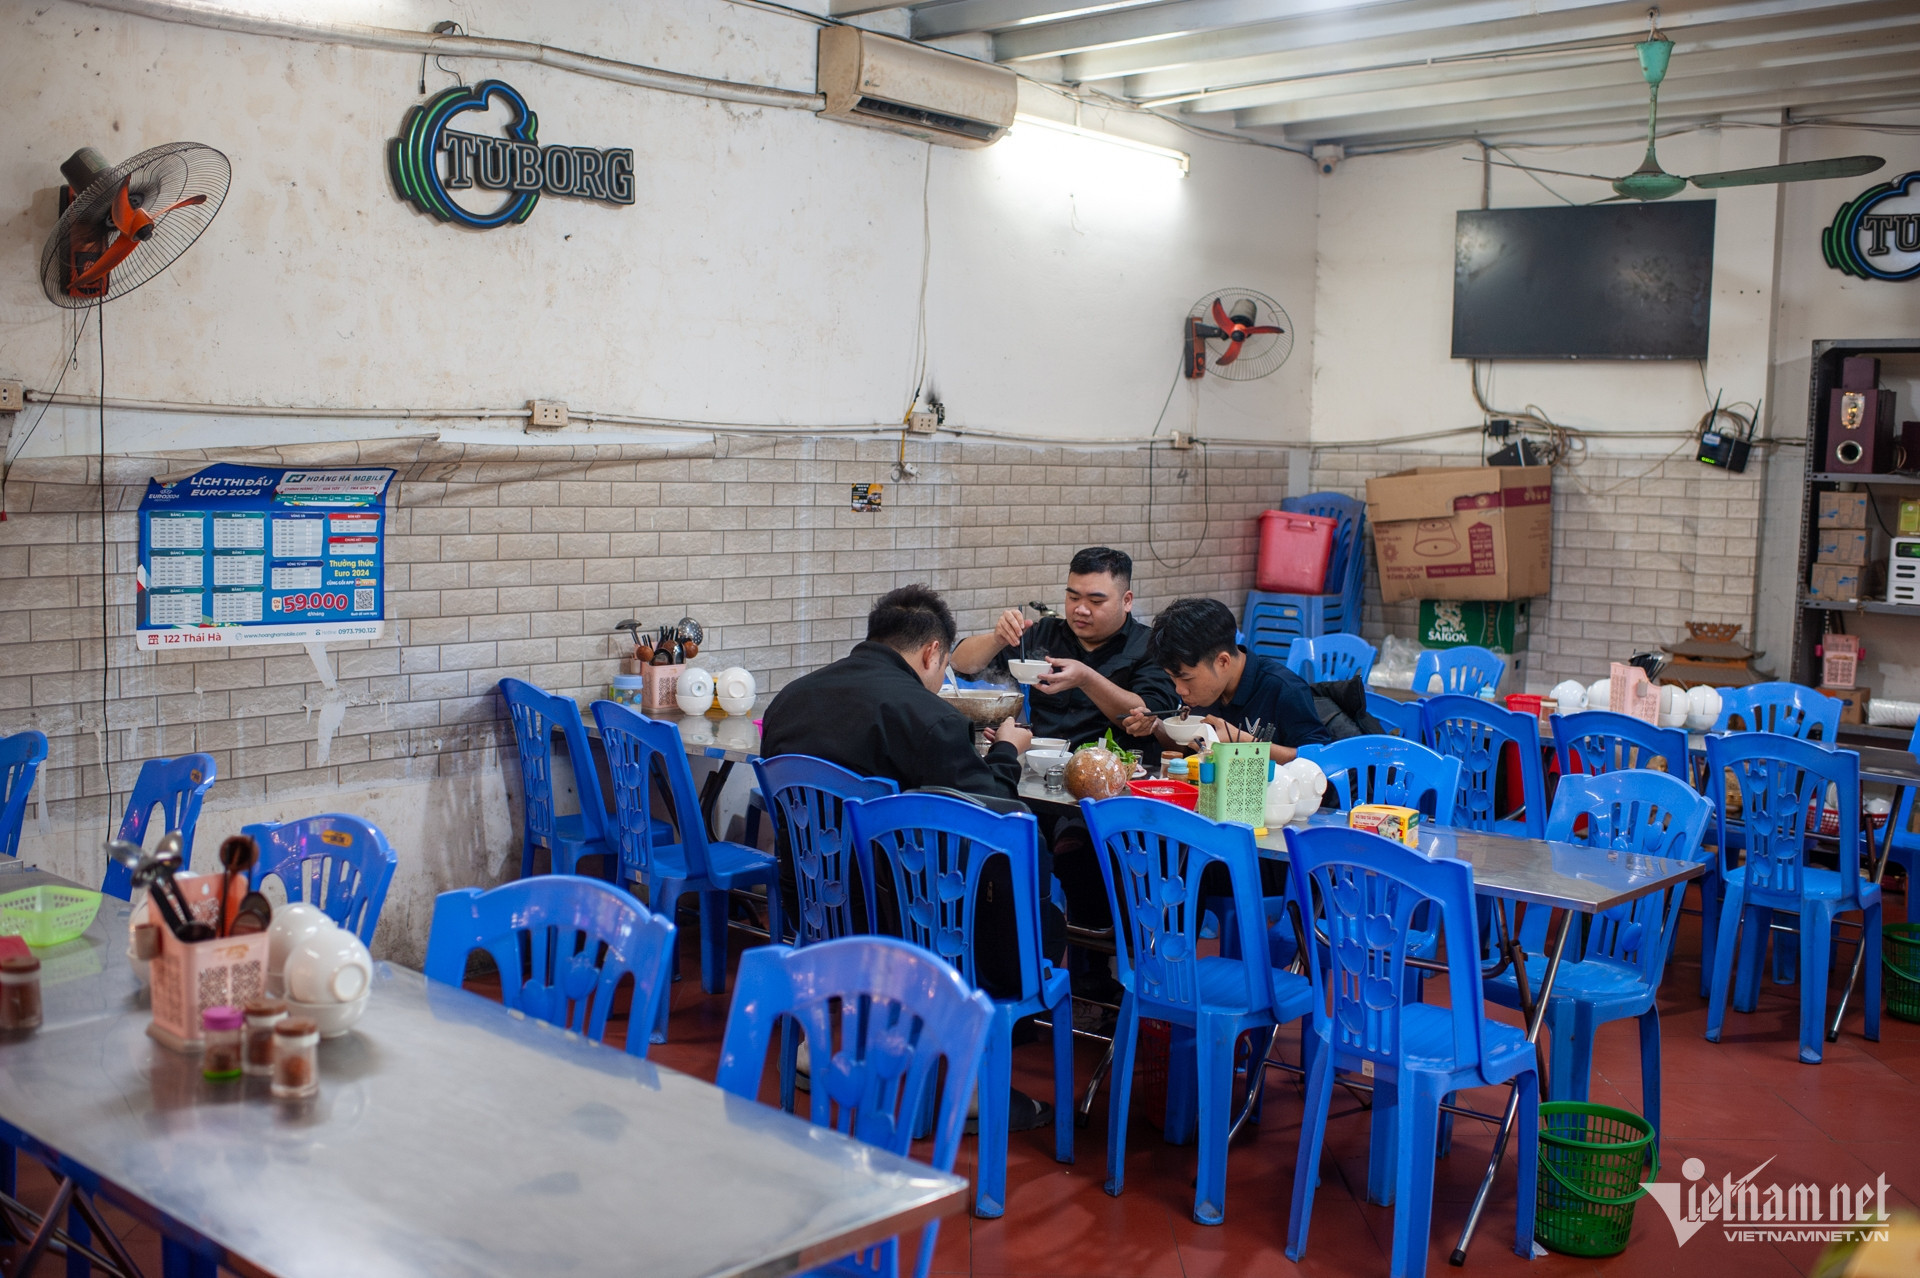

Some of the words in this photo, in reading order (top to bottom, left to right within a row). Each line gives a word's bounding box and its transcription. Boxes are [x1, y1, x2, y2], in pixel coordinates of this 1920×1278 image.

[442, 128, 636, 205] TUBORG
[190, 477, 221, 488] LỊCH
[223, 478, 245, 487] THI
[245, 476, 273, 487] ĐẤU
[352, 474, 386, 482] MOBILE
[190, 489, 227, 497] EURO
[227, 488, 261, 497] 2024
[357, 559, 374, 567] thức
[352, 569, 370, 577] 2024
[283, 592, 349, 613] 59.000
[164, 634, 180, 643] 122
[182, 632, 205, 642] Thái
[208, 632, 222, 642] Hà
[1428, 630, 1467, 643] SAIGON
